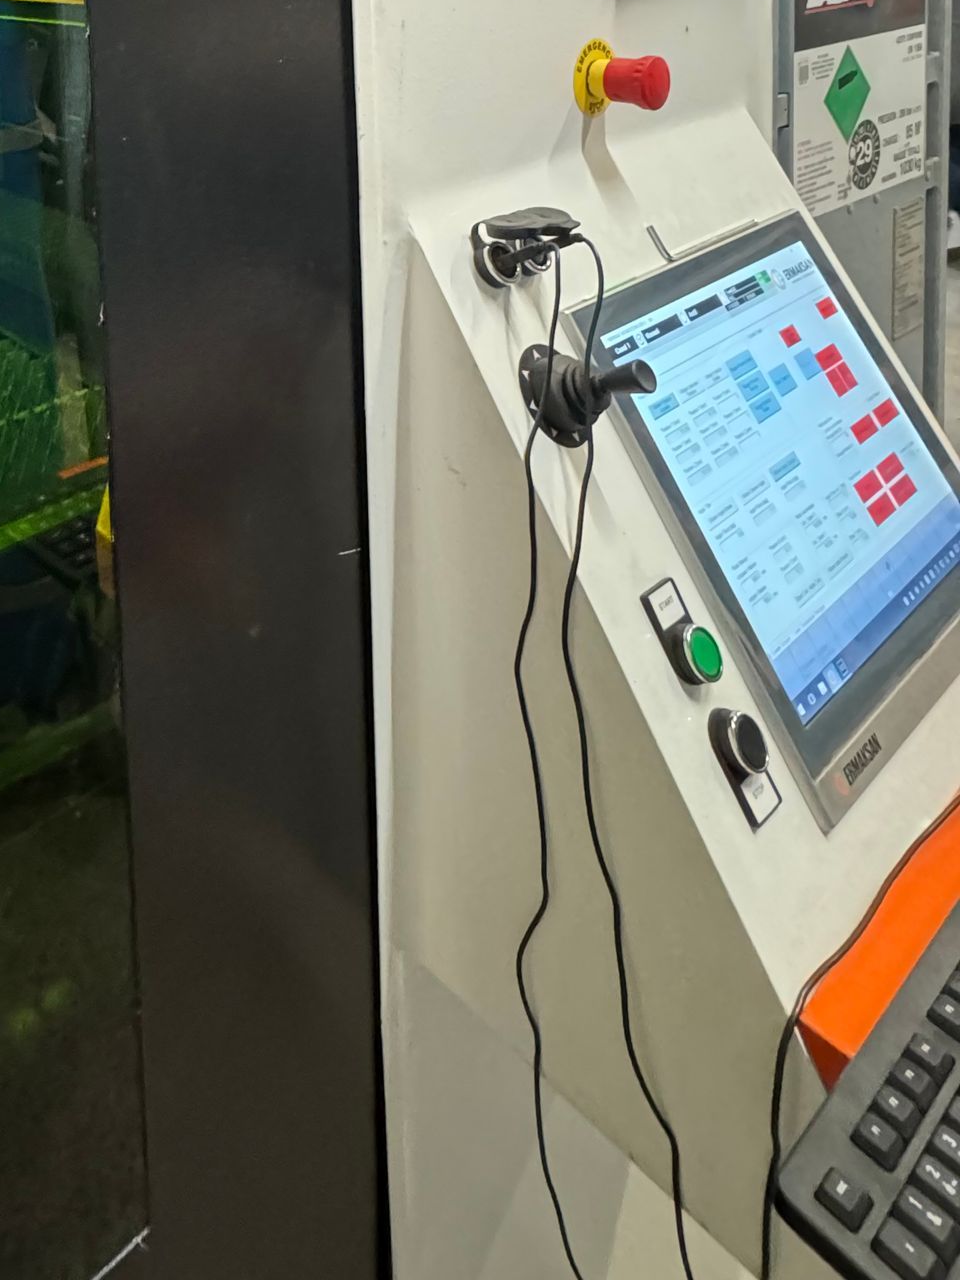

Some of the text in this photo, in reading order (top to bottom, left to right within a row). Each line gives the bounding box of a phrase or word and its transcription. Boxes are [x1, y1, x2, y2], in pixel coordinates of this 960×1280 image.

[577, 41, 613, 73] EMERGENC
[856, 140, 873, 167] 29
[658, 595, 674, 612] START
[843, 733, 882, 787] ERMAKSAN
[942, 1133, 957, 1148] 3
[925, 1164, 941, 1180] 2
[908, 1195, 923, 1210] 1
